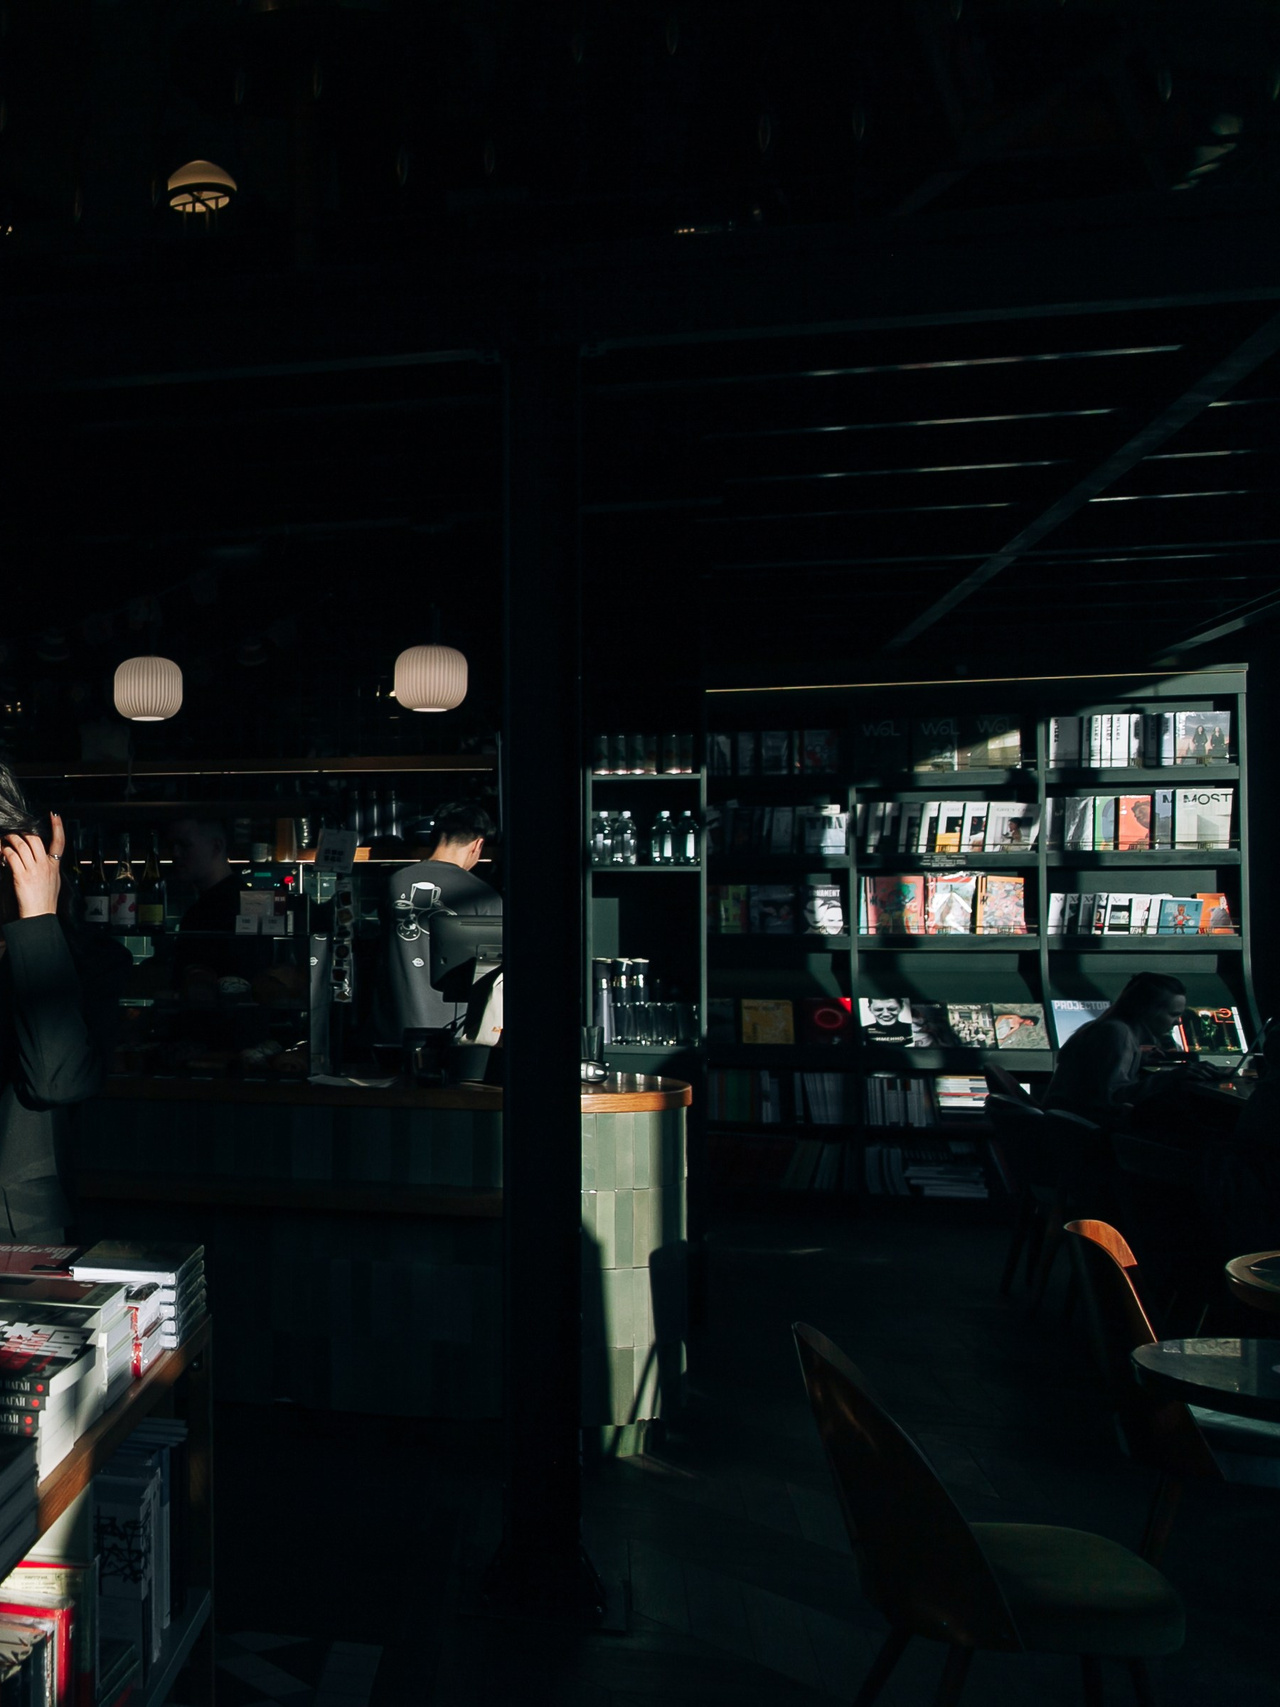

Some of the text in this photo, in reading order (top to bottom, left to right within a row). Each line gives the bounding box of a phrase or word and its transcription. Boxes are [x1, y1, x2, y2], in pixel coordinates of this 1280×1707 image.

[1183, 793, 1233, 805] MOST
[1054, 1000, 1110, 1010] PROJECTOR
[5, 1378, 31, 1392] НАГАЙ
[0, 1393, 26, 1407] НАГАЙ
